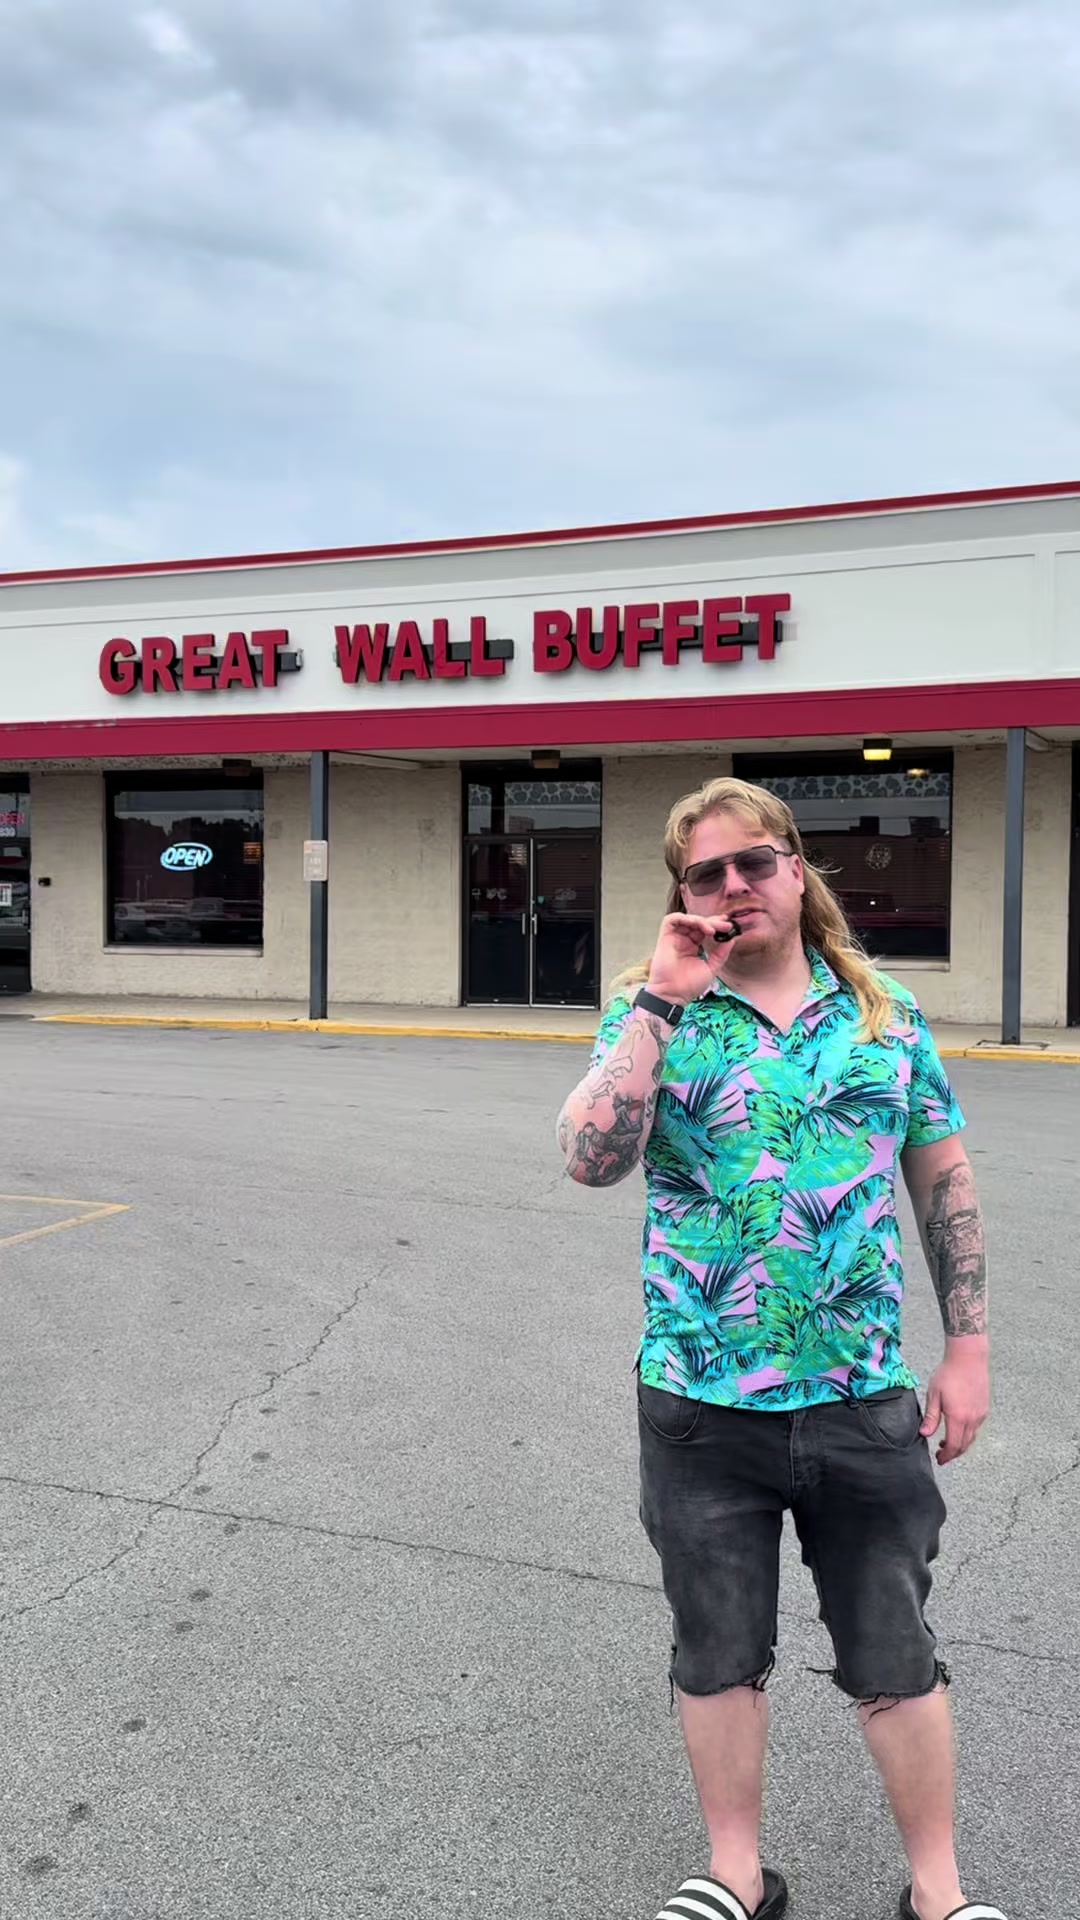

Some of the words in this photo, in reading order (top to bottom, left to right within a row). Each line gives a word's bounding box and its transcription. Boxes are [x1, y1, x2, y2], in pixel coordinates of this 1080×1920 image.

[99, 629, 289, 695] GREAT
[334, 616, 506, 684] WALL
[533, 592, 791, 673] BUFFET
[164, 847, 207, 867] OPEN
